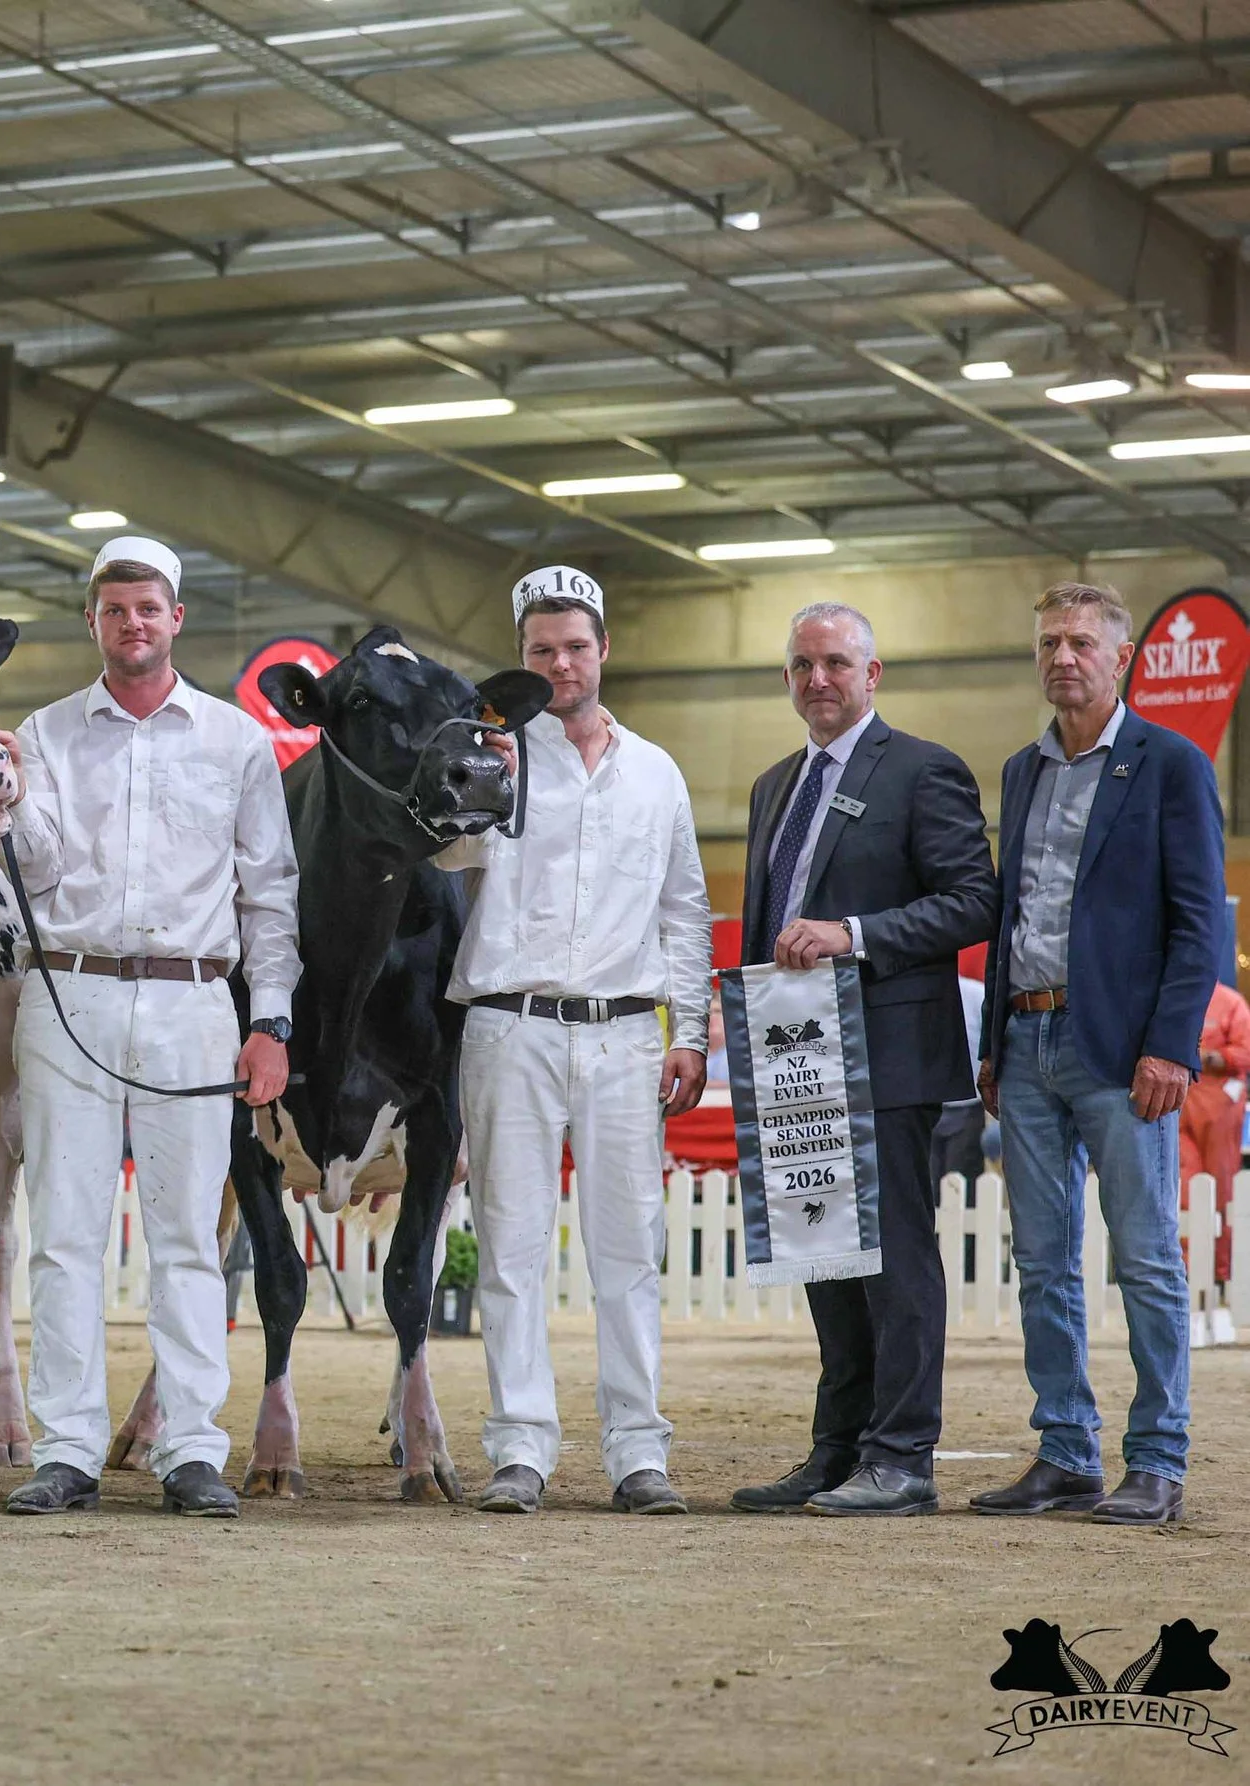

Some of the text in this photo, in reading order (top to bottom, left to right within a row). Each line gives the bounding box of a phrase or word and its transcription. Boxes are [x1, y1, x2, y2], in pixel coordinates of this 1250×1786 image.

[551, 570, 596, 604] 162
[1143, 637, 1222, 680] SEMEX
[787, 1055, 808, 1070] NZ
[774, 1068, 822, 1086] DAIRY
[773, 1082, 825, 1101] EVENT
[762, 1106, 846, 1129] CHAMPION
[777, 1123, 832, 1142] SENIOR
[768, 1136, 845, 1159] HOLSTEIN
[784, 1166, 836, 1191] 2026
